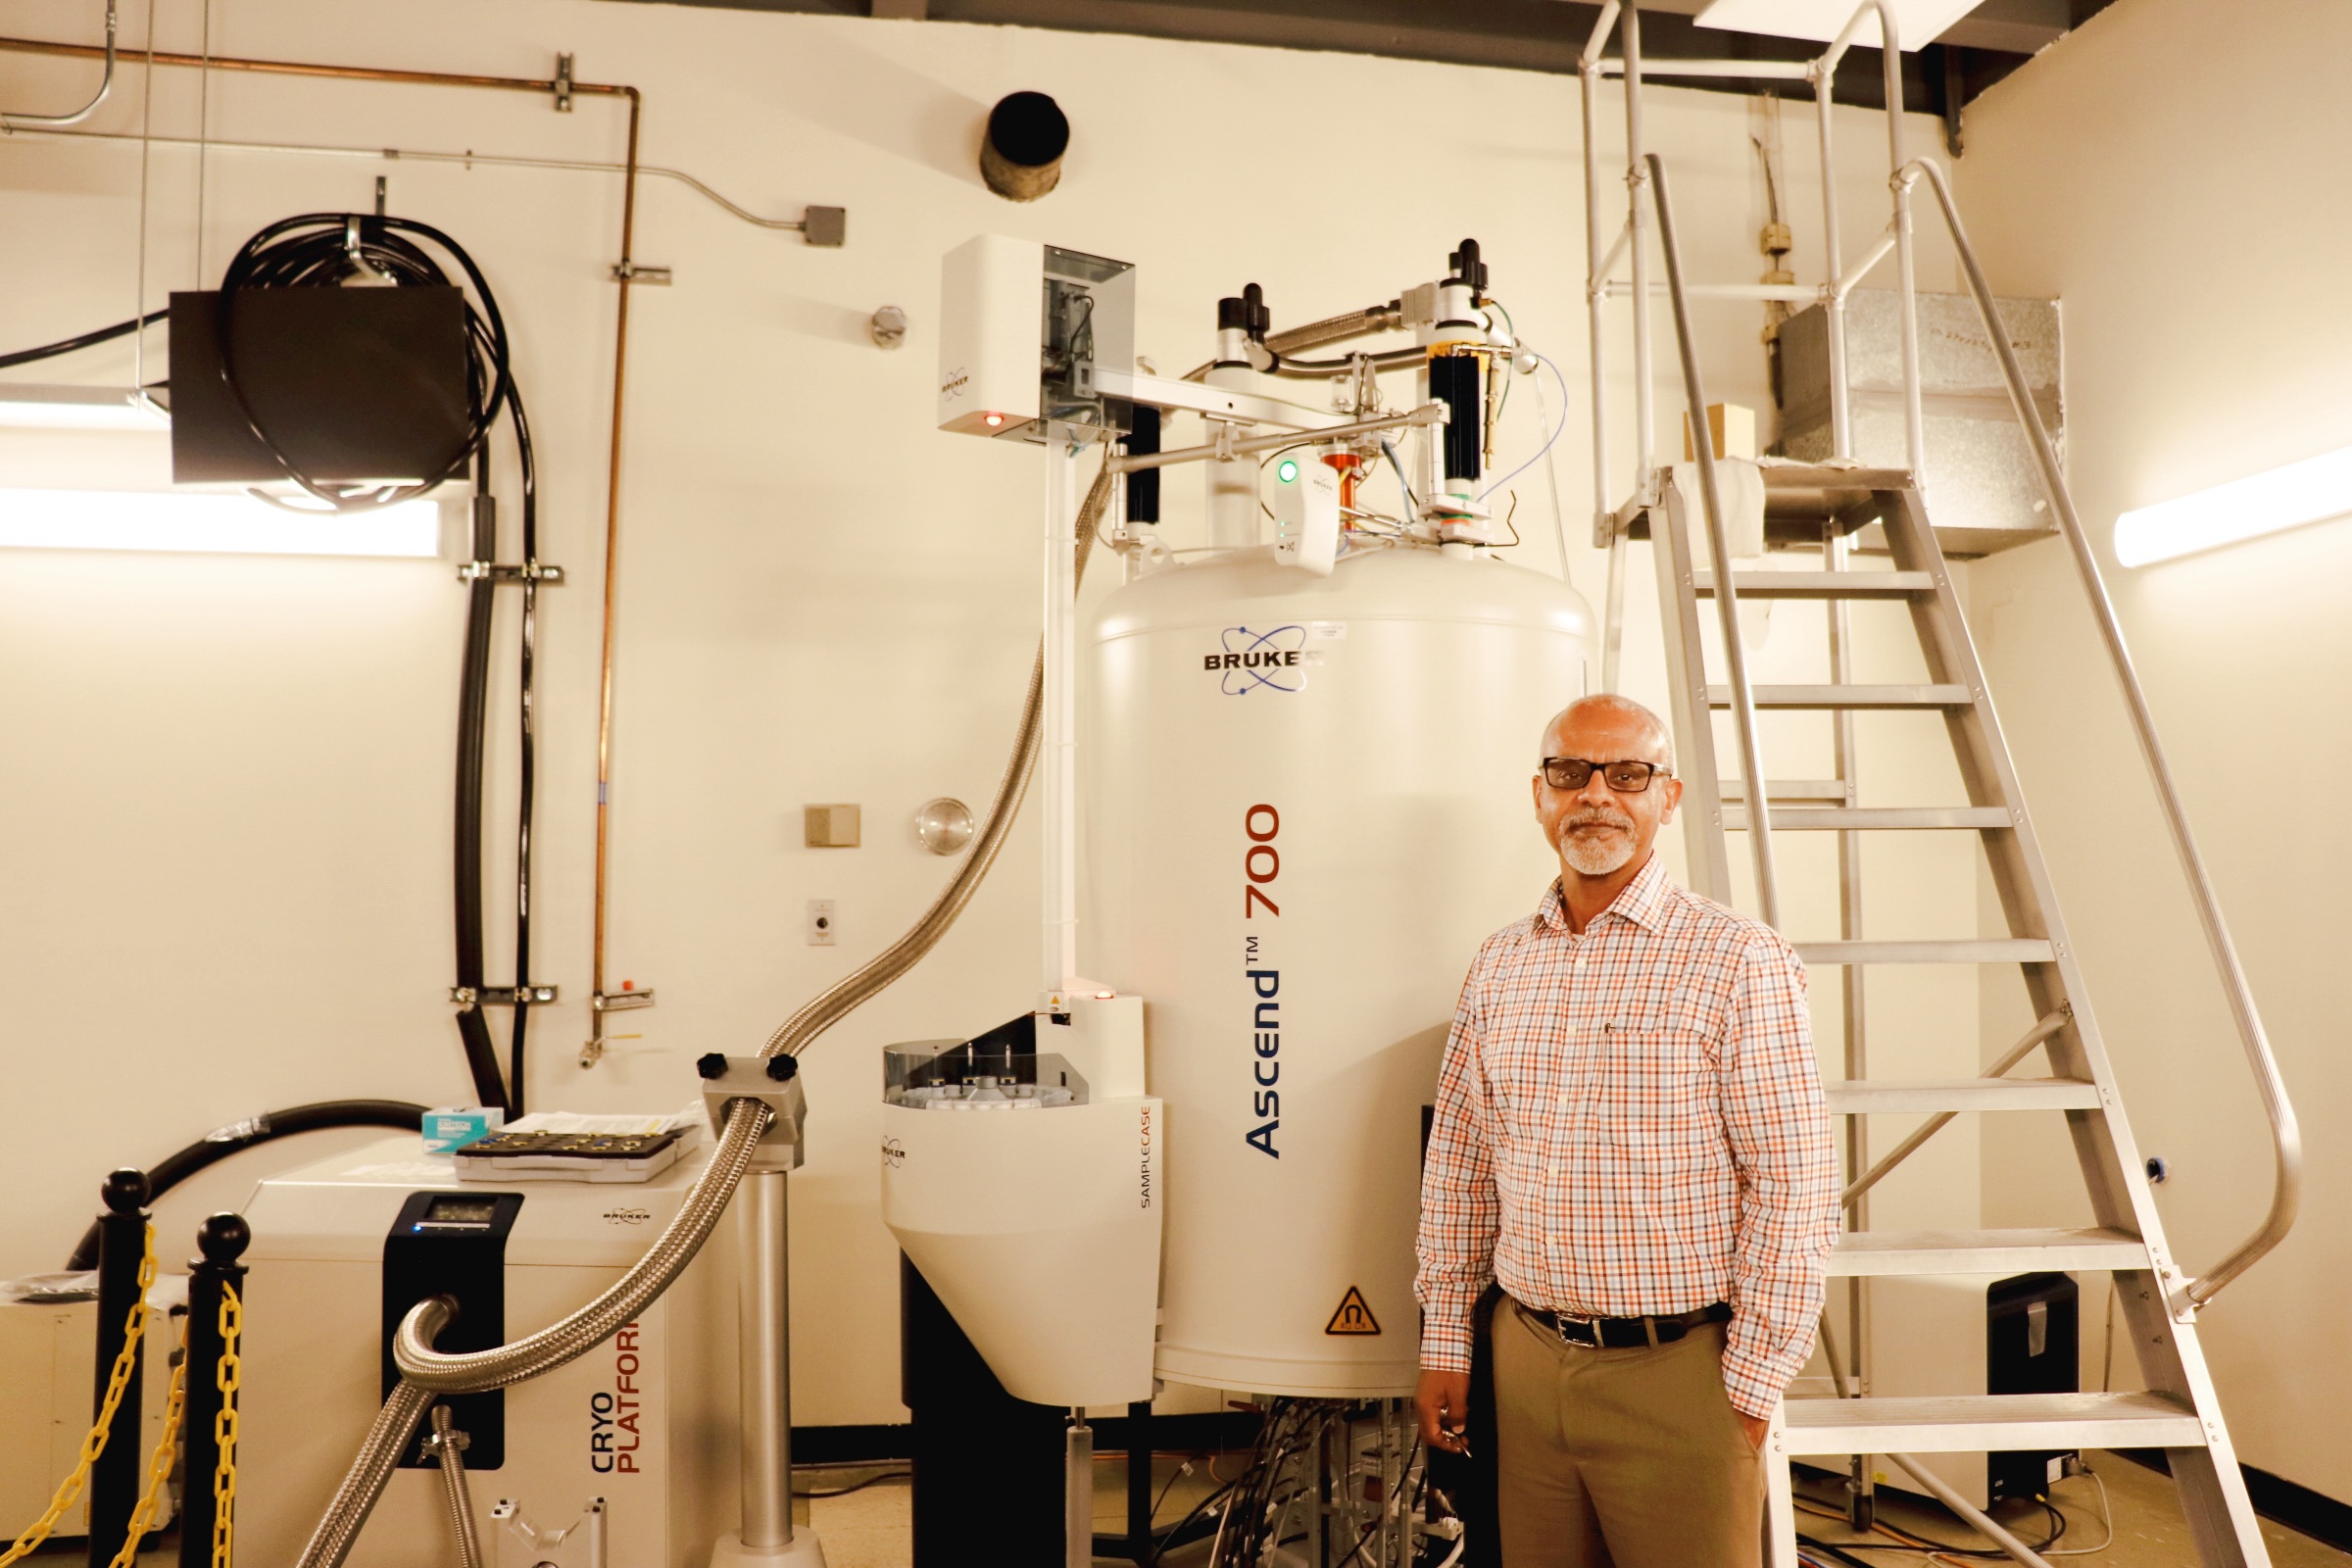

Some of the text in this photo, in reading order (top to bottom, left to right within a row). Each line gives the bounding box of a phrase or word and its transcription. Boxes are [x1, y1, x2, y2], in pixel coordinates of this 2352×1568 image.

[1246, 804, 1279, 918] 700
[1141, 1106, 1151, 1209] SAMPLECASE
[591, 1392, 613, 1473] CRYO
